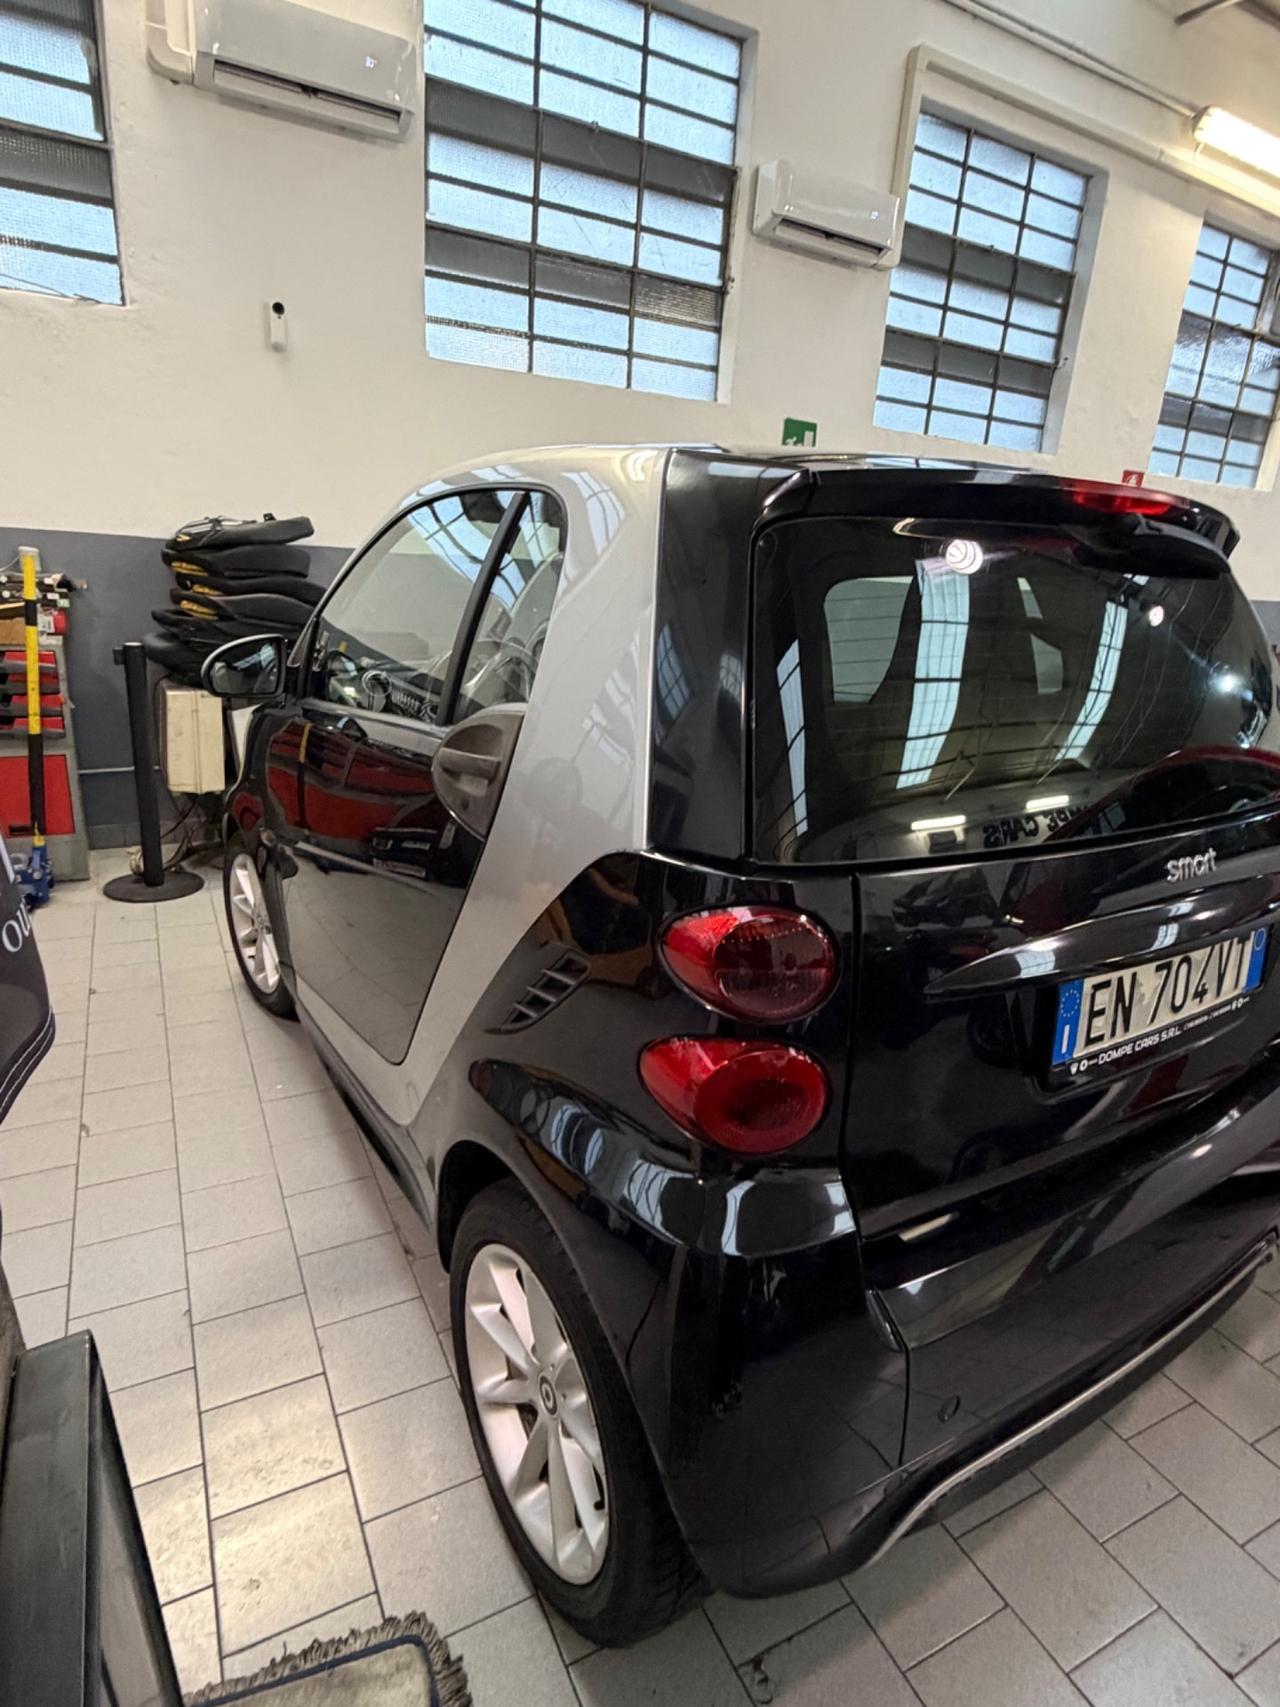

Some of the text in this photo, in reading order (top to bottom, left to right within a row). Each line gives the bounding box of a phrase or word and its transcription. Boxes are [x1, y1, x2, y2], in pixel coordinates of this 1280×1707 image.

[1167, 847, 1217, 882] smart
[1084, 973, 1138, 1048] EN
[1134, 1033, 1160, 1052] CARS
